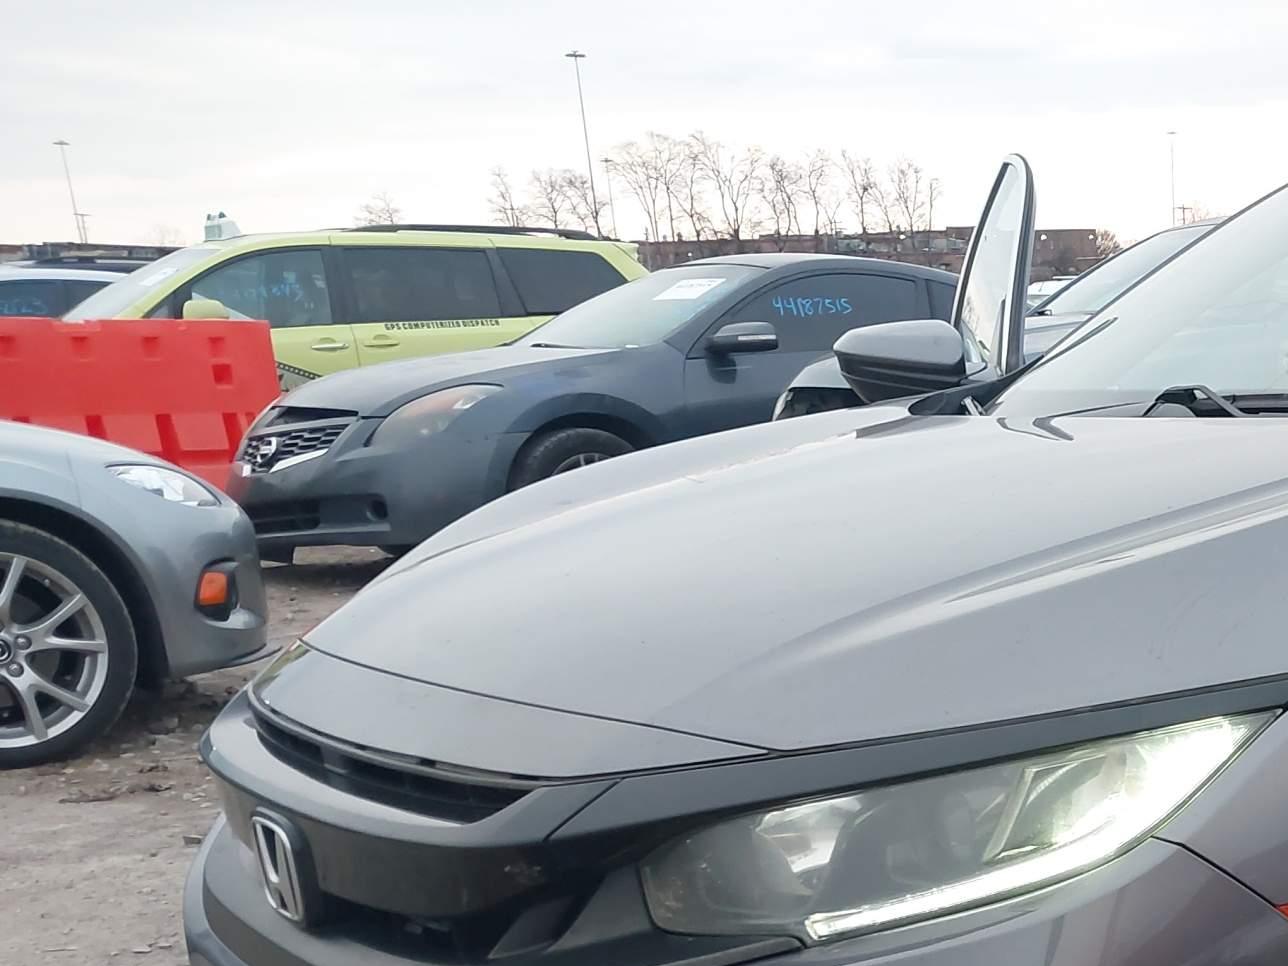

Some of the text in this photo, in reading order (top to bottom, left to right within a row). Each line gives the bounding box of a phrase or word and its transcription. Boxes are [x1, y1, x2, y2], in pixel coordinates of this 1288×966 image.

[772, 296, 853, 318] 44187515
[384, 319, 500, 331] GPS COMPUTERIZED DISPATCH
